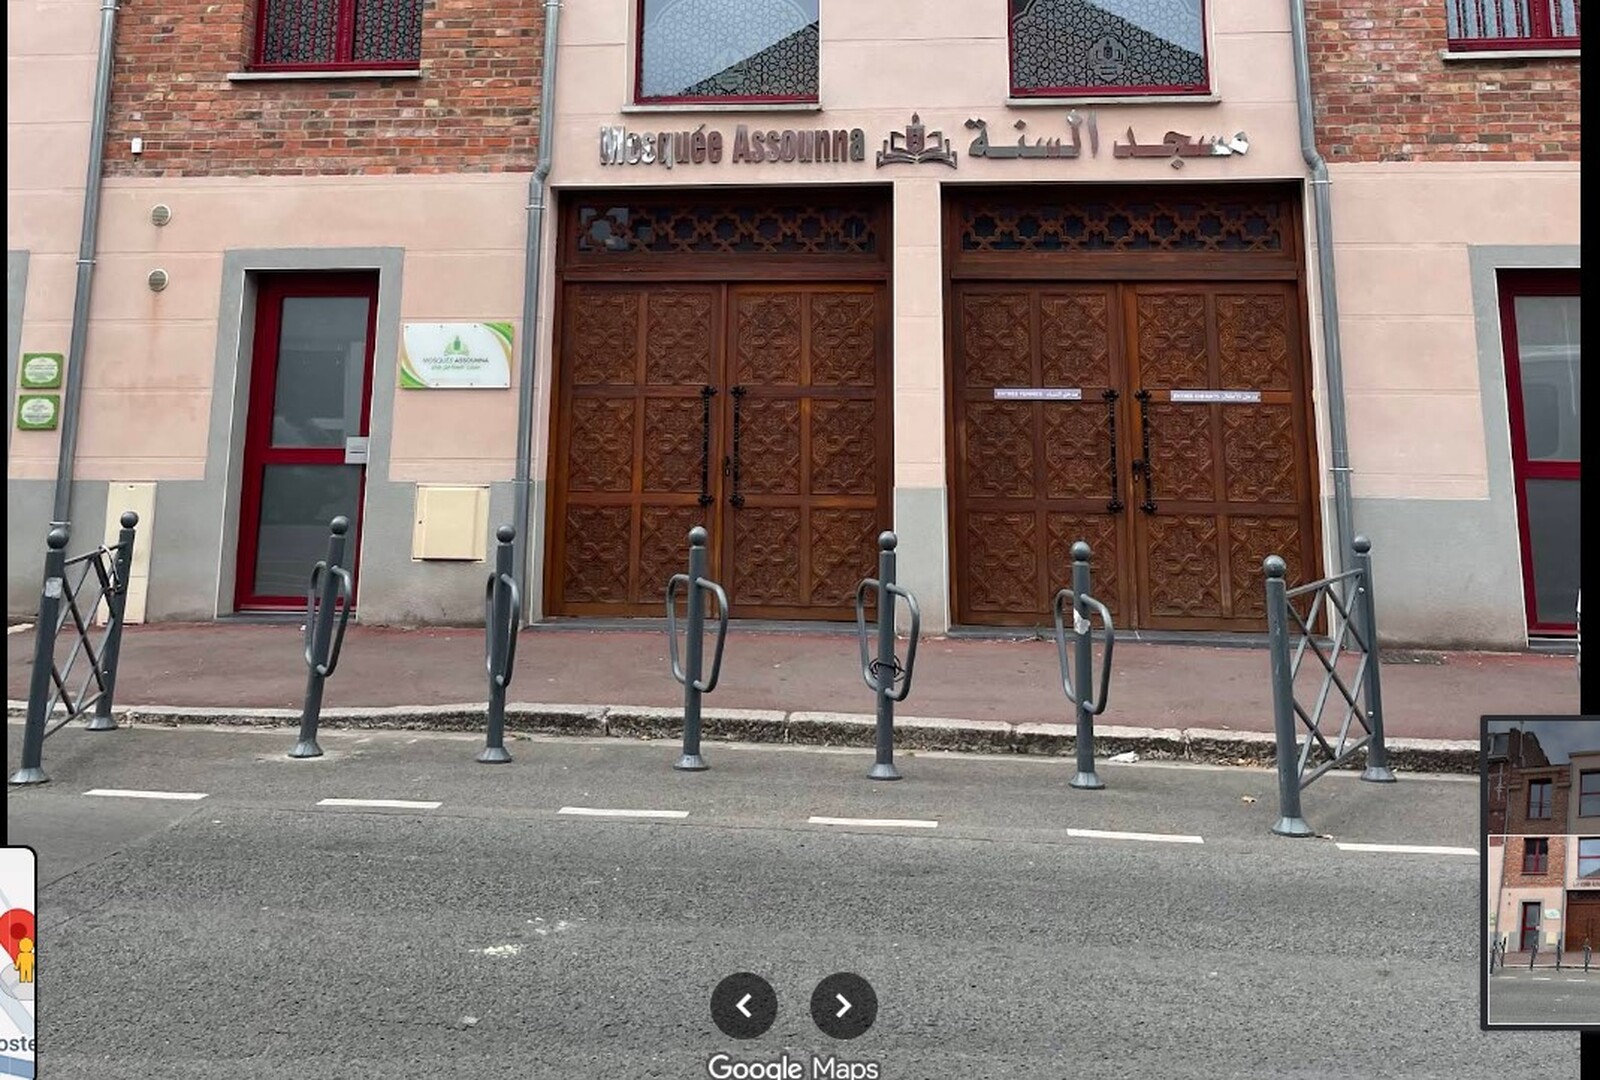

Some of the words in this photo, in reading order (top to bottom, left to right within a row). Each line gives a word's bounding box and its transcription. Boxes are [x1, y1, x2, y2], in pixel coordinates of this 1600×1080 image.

[599, 124, 723, 169] Mosquée
[732, 124, 866, 163] Assounna
[964, 108, 1099, 159] السنة
[1112, 125, 1249, 170] مسجد
